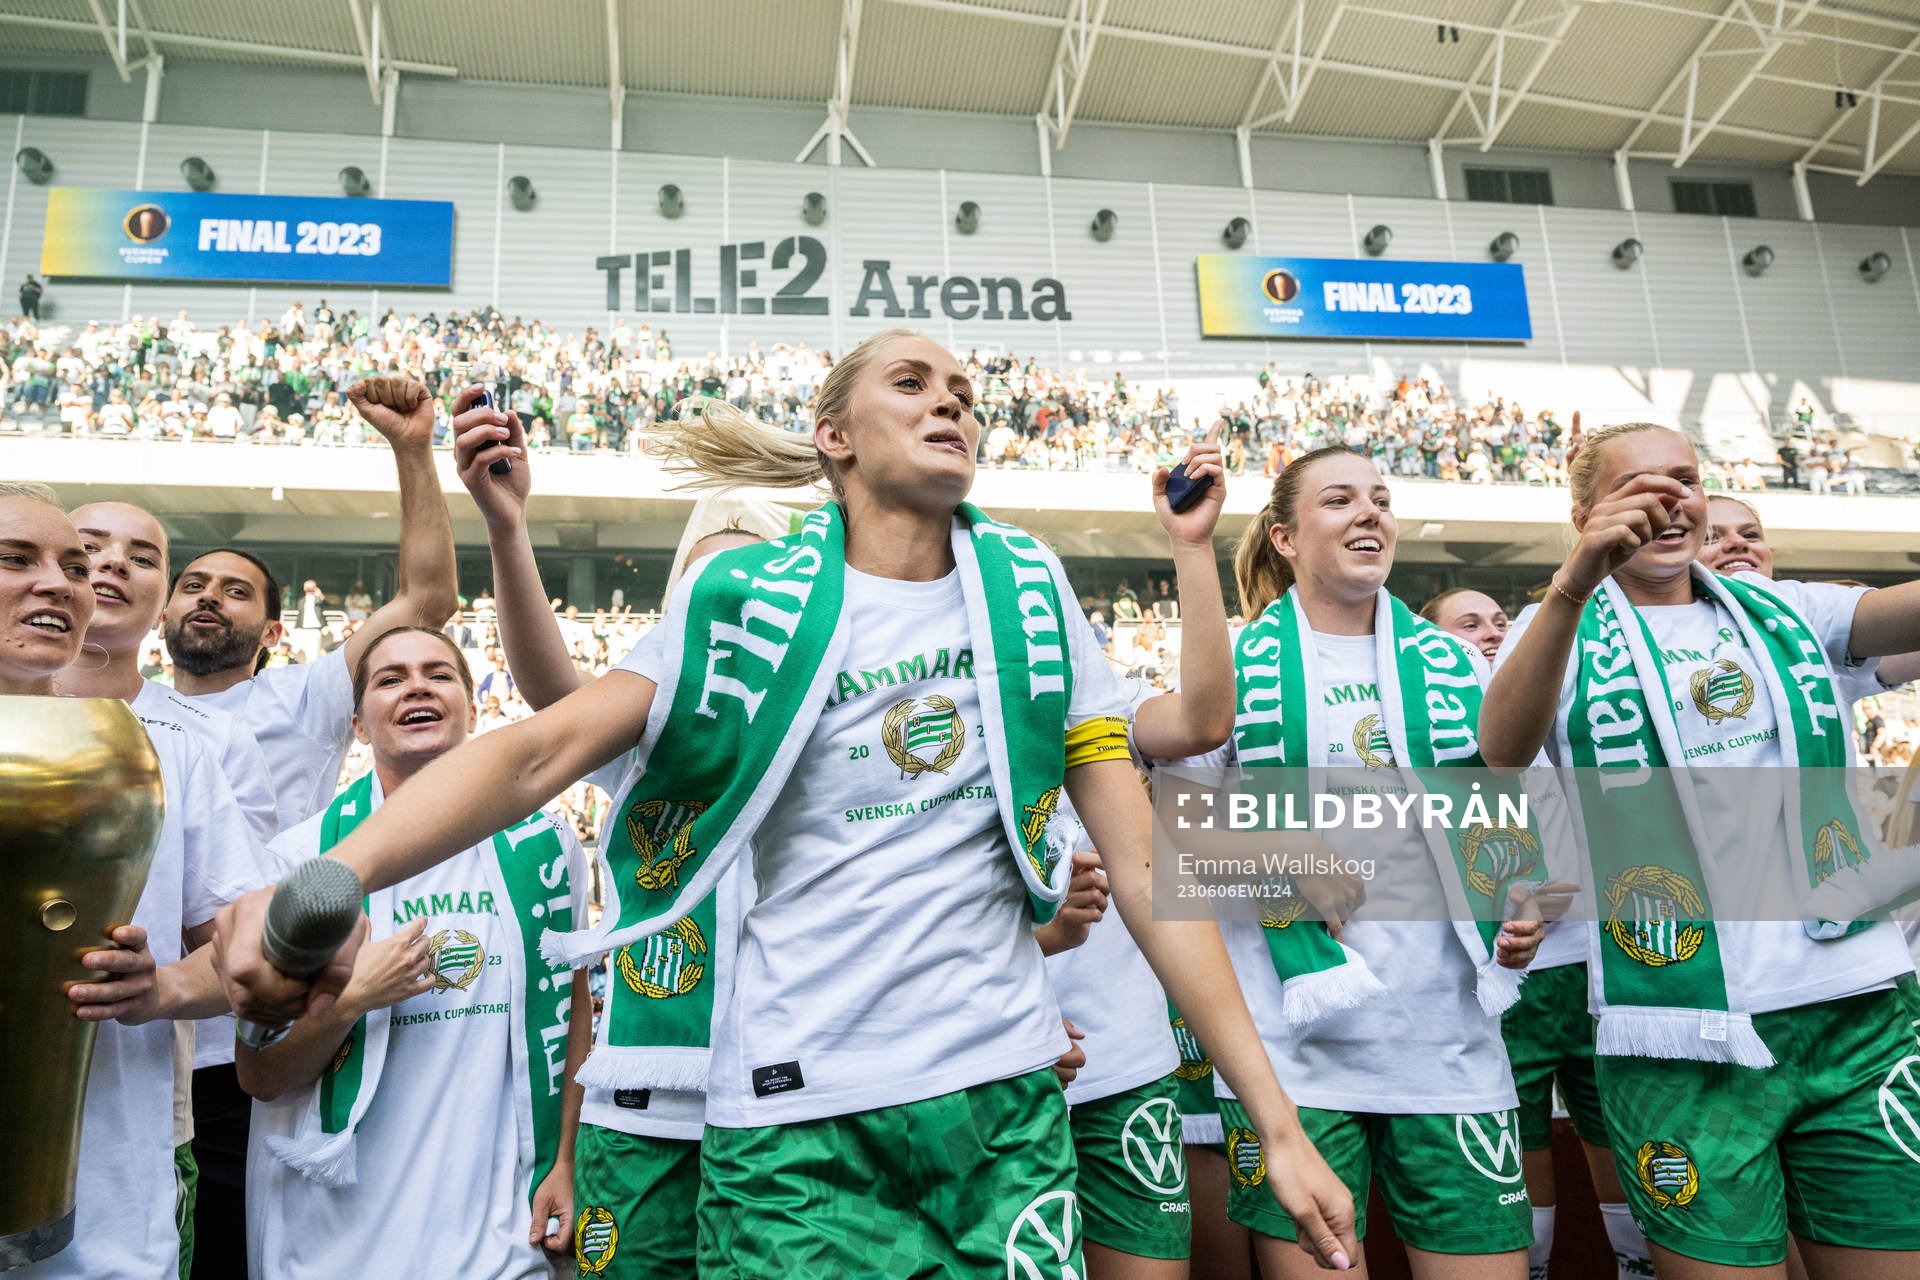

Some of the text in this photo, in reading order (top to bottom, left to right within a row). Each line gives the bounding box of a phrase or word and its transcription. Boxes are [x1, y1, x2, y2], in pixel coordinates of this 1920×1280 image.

[198, 218, 382, 256] FINAL 2023
[596, 236, 1072, 321] TELE2 Arena
[1323, 281, 1473, 315] FINAL 2023
[849, 744, 870, 760] 20
[1329, 743, 1343, 753] 20
[845, 784, 998, 823] SVENSKA CUPMÄSTA
[488, 955, 502, 966] 23
[389, 1011, 441, 1027] SVENSKA
